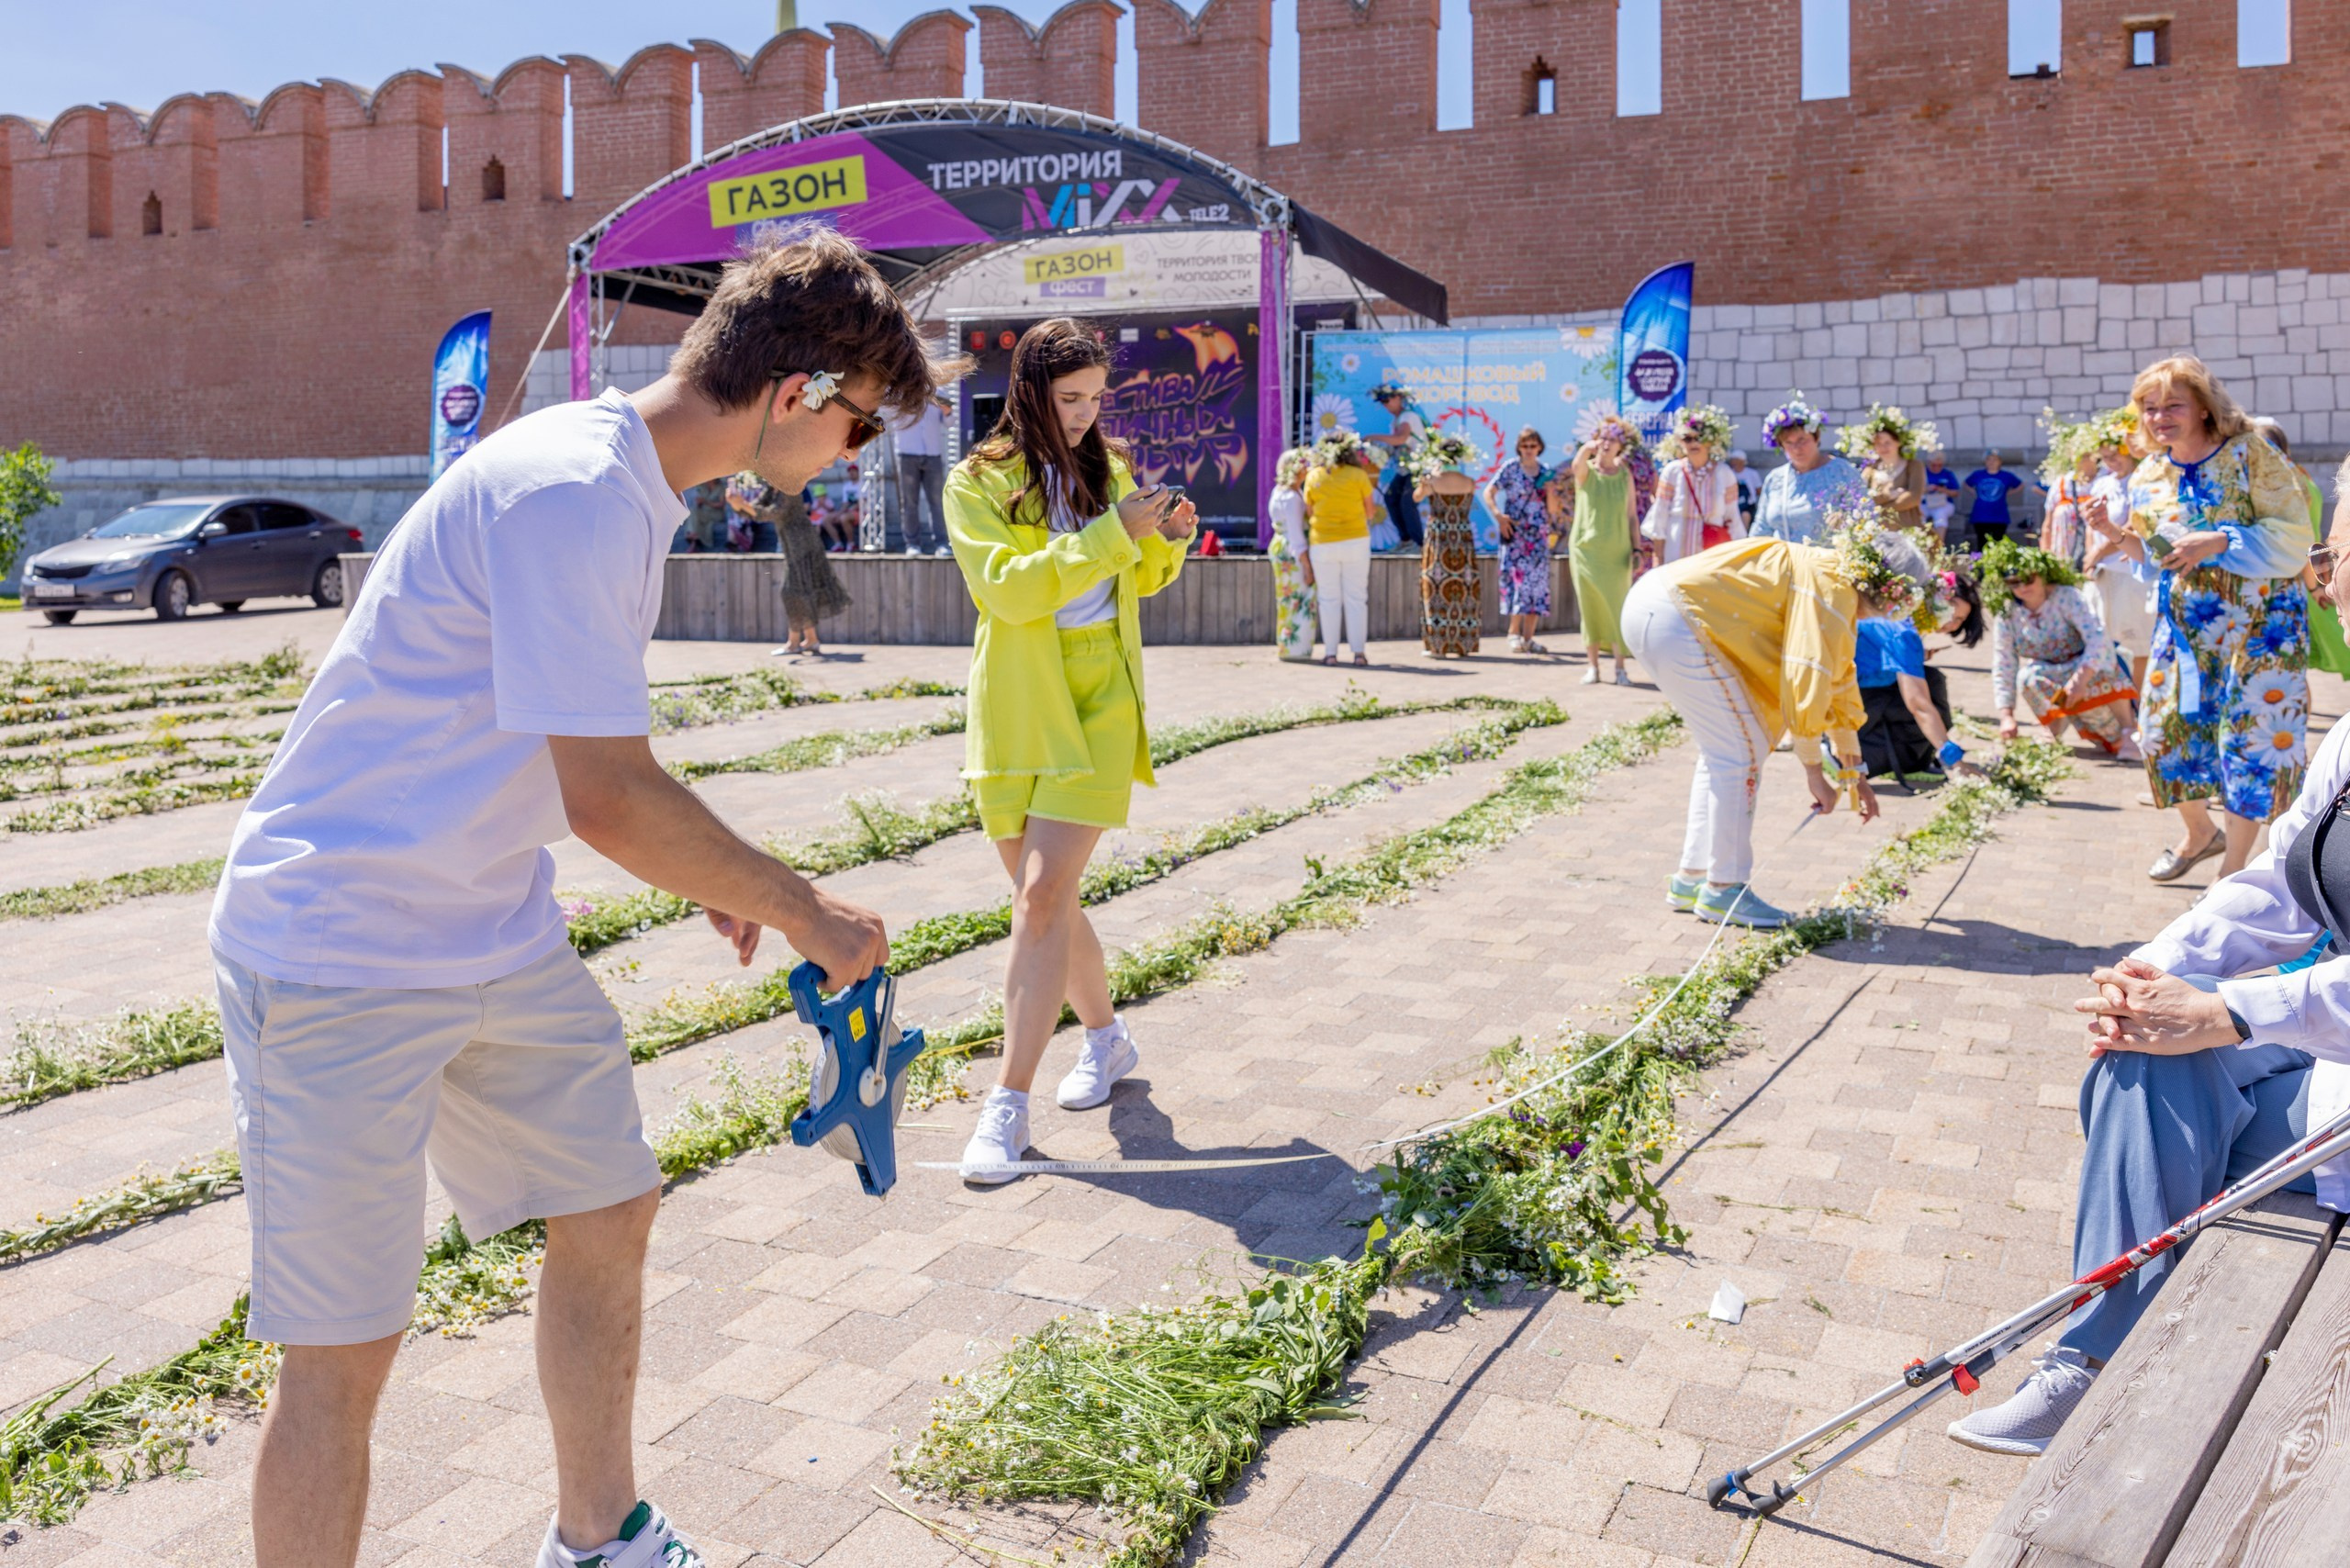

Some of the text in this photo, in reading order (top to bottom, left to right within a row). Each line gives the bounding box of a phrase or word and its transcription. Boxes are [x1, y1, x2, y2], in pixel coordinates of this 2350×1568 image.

[927, 150, 1123, 191] ТЕРРИТОРИЯ
[728, 167, 846, 216] ГАЗОН
[1189, 203, 1230, 222] TELE2
[1035, 250, 1113, 279] ГАЗОН
[1157, 252, 1261, 268] ТЕРРИТОРИЯ ТВОЕ
[1049, 279, 1096, 296] фест
[1173, 269, 1252, 284] МОЛОДОСТИ
[1382, 360, 1547, 385] РОМАШКОВЫЙ
